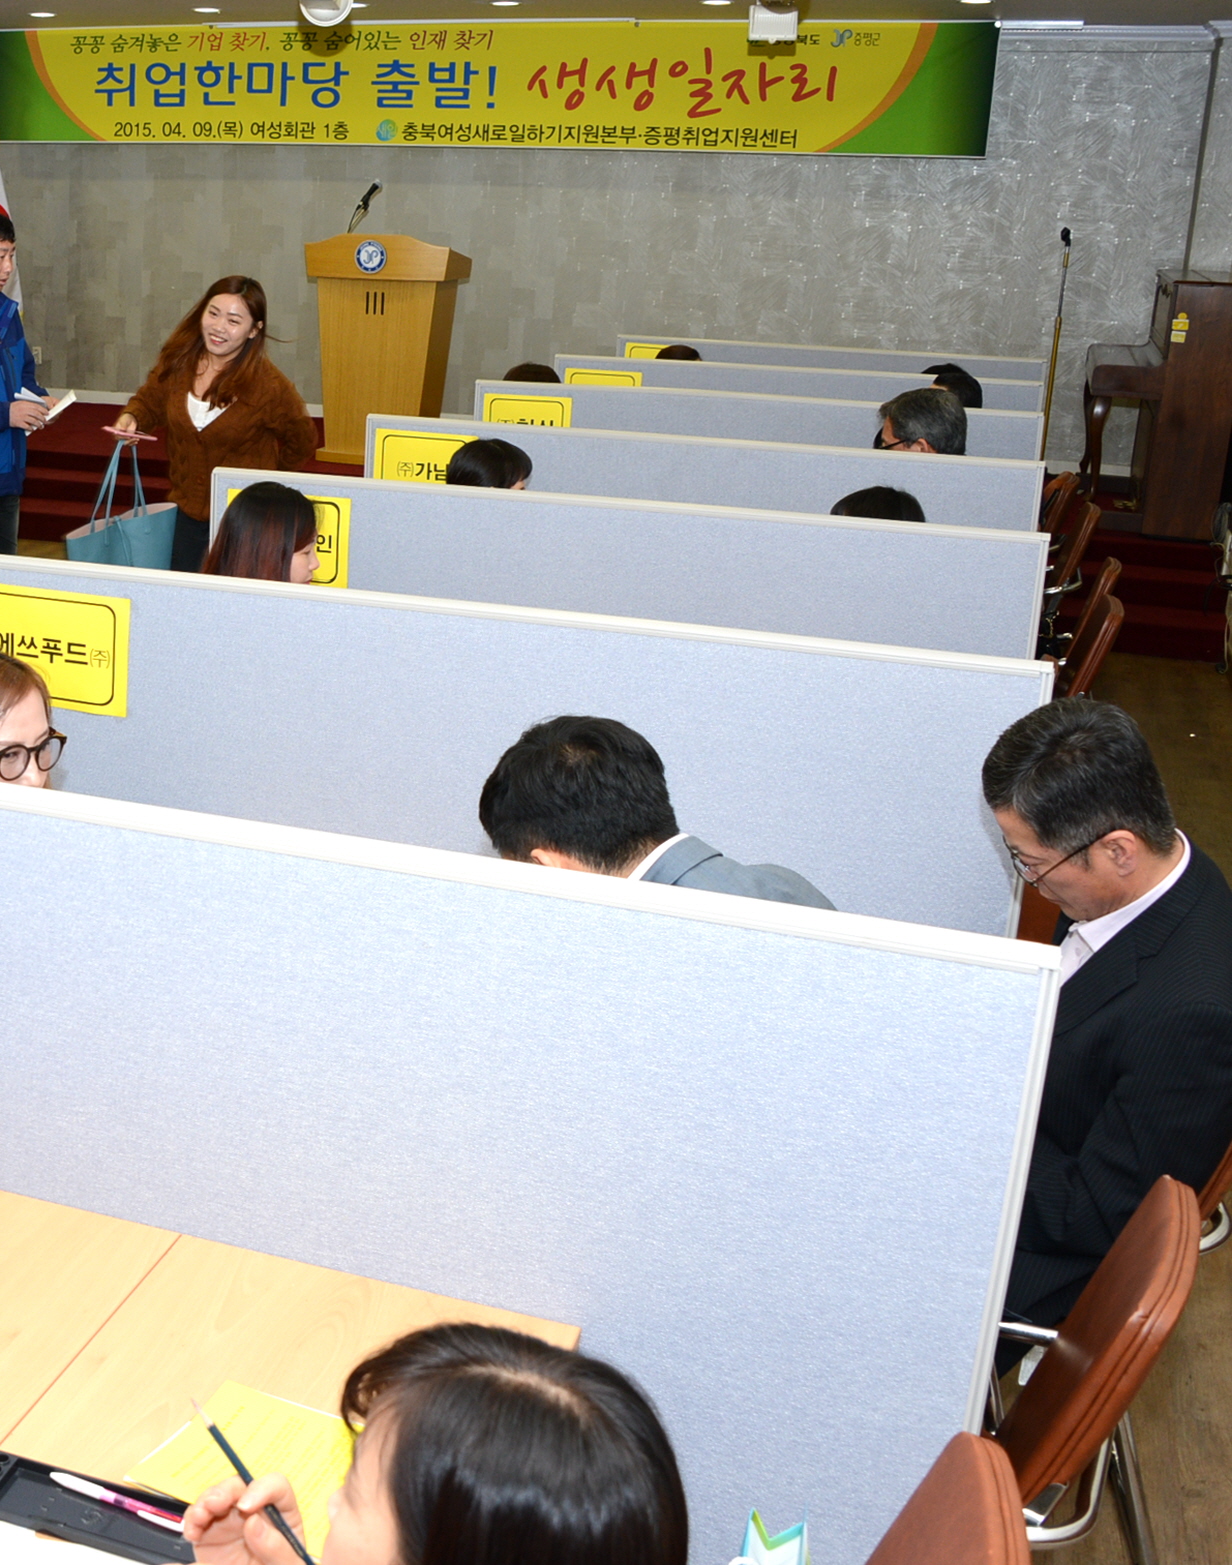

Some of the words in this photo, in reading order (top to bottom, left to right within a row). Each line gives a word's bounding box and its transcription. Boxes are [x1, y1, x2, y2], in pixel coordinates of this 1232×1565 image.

[70, 34, 106, 54] 꽁꽁
[111, 33, 182, 54] 숨겨놓은
[188, 31, 224, 52] 기업
[323, 30, 402, 52] 숨어있는
[409, 31, 447, 52] 인재
[453, 30, 494, 51] 찾기
[94, 60, 350, 108] 취업한마당
[371, 59, 498, 109] 출발!
[526, 47, 839, 119] 생생일자리
[113, 121, 157, 139] 2015.
[162, 121, 187, 139] 04.
[192, 119, 244, 140] 09.(목)
[250, 121, 316, 140] 여성회관
[323, 121, 350, 140] 1층
